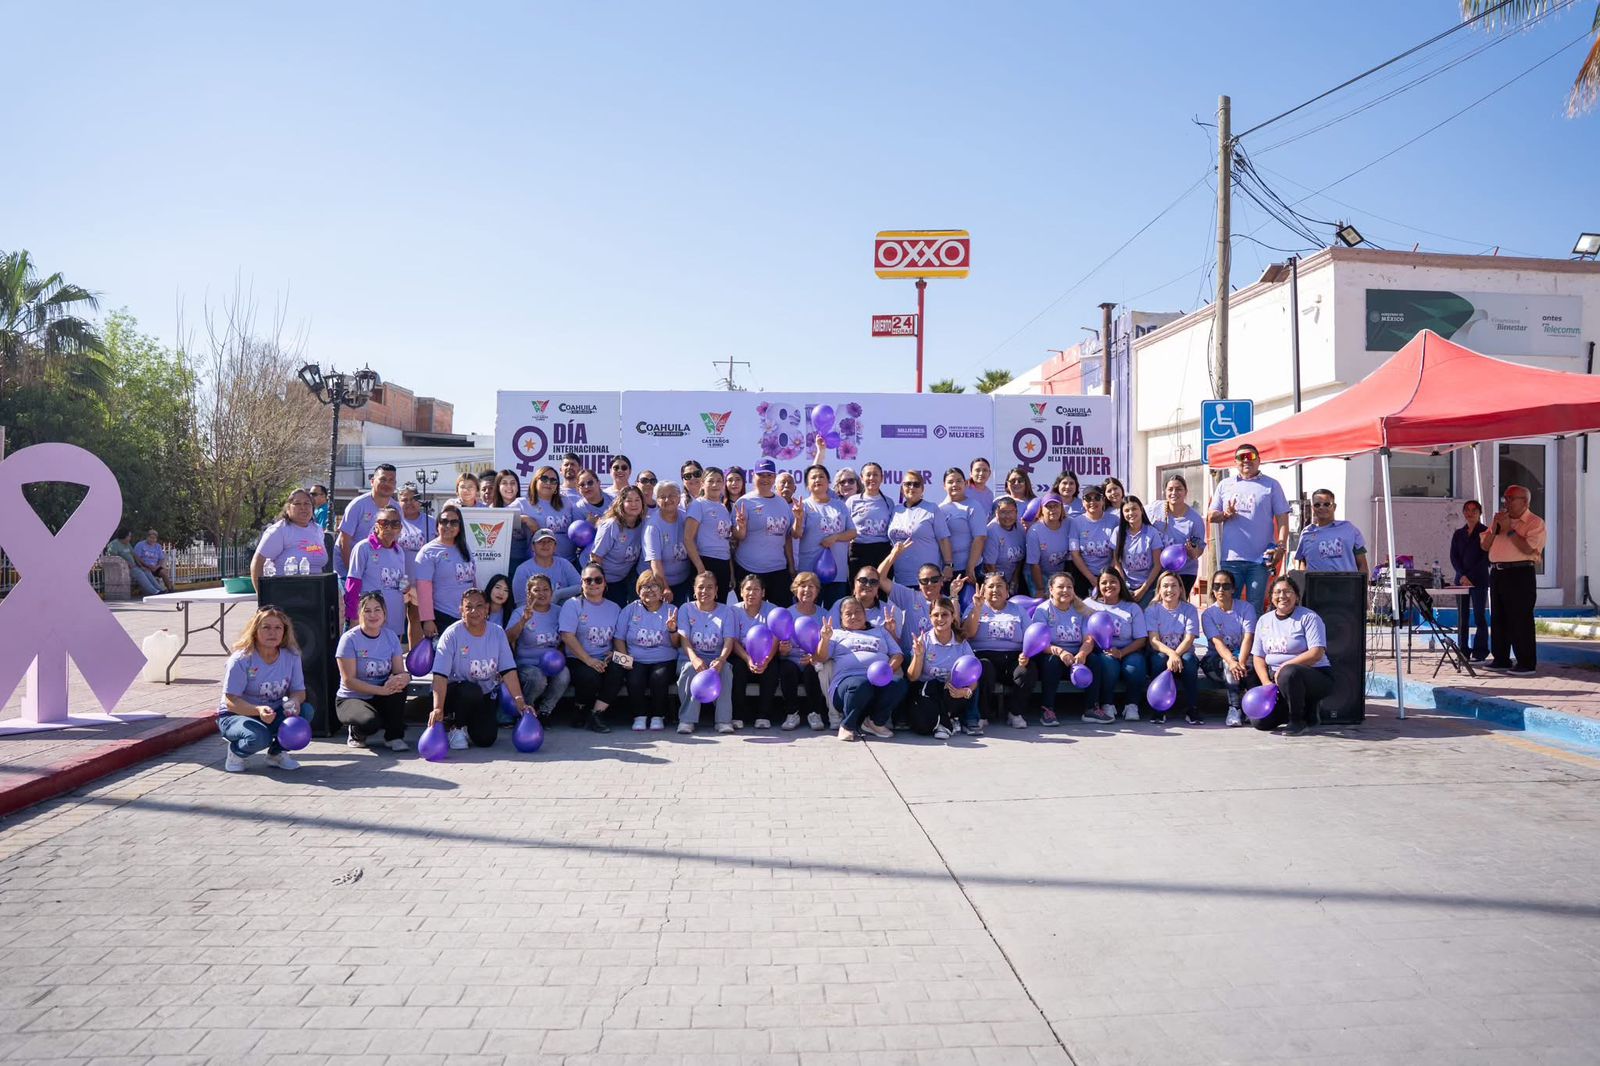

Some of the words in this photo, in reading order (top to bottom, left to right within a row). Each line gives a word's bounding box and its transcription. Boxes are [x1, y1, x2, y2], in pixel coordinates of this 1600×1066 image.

[878, 240, 965, 268] OXXO
[893, 317, 912, 328] 24
[1496, 323, 1528, 331] Bienestar
[558, 403, 597, 412] COAHUILA
[1056, 406, 1091, 415] COAHUILA
[554, 419, 588, 444] DÍA
[636, 421, 691, 434] COAHUILA
[1052, 422, 1084, 446] DÍA
[553, 445, 609, 453] INTERNACIONAL
[1052, 446, 1104, 455] INTERNACIONAL
[1062, 456, 1110, 475] MUJER
